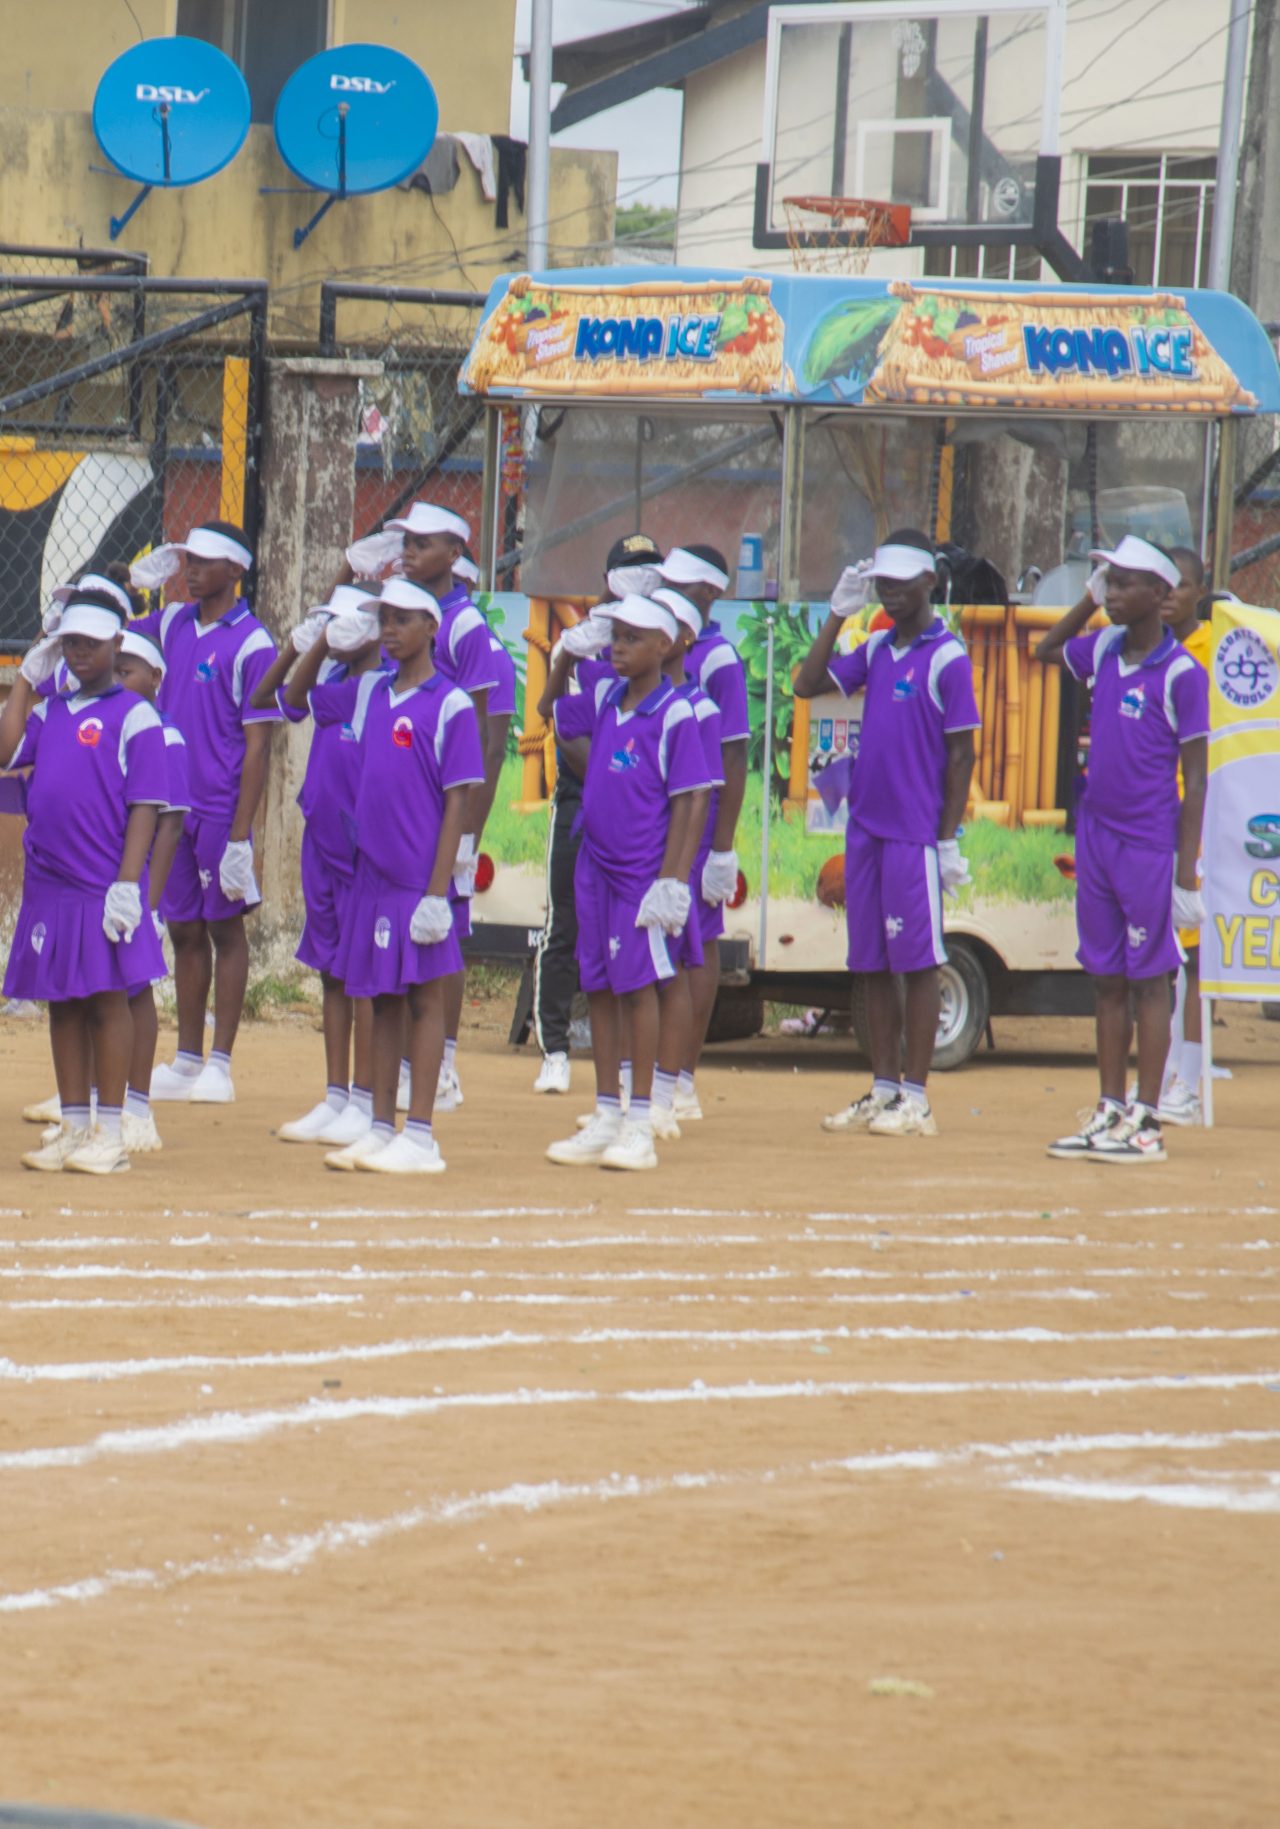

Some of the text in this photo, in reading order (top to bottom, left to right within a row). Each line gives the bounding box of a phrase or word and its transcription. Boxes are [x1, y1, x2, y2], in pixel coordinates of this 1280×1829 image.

[574, 313, 721, 365] KONA ICE
[1022, 324, 1200, 379] KONA ICE
